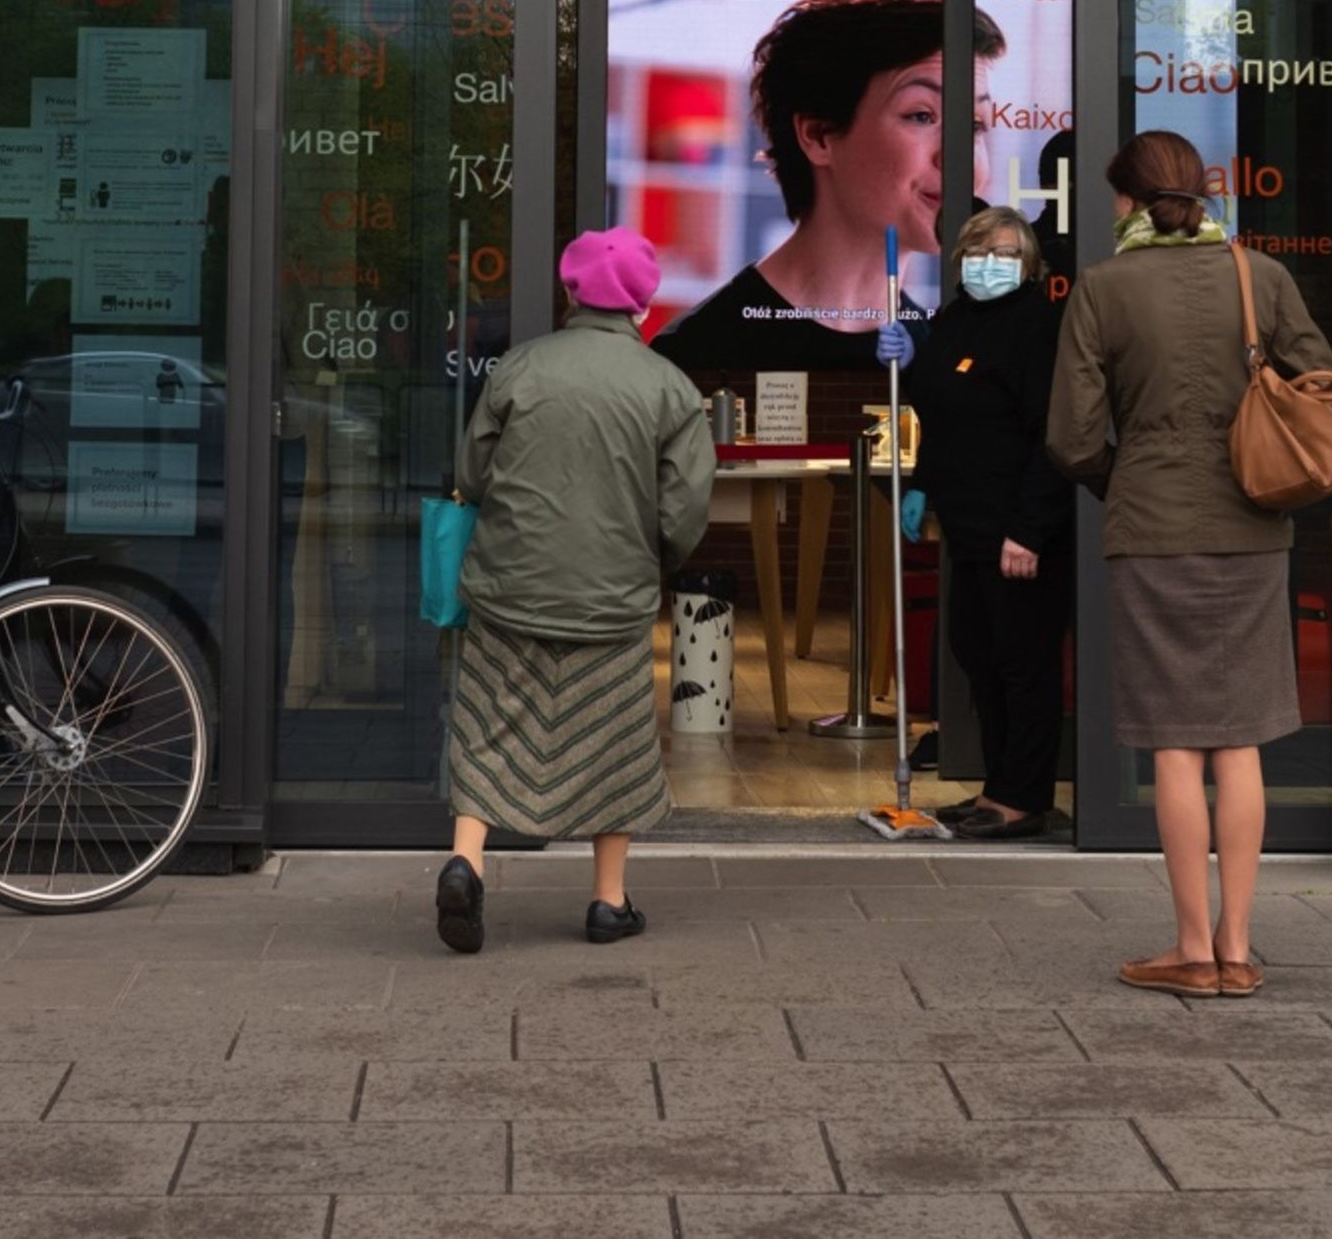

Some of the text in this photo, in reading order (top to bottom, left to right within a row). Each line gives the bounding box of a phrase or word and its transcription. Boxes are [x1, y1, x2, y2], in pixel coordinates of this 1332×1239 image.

[1134, 50, 1238, 94] Ciao
[281, 128, 382, 156] ивет
[895, 307, 923, 322] użo.
[301, 330, 378, 360] Ciao
